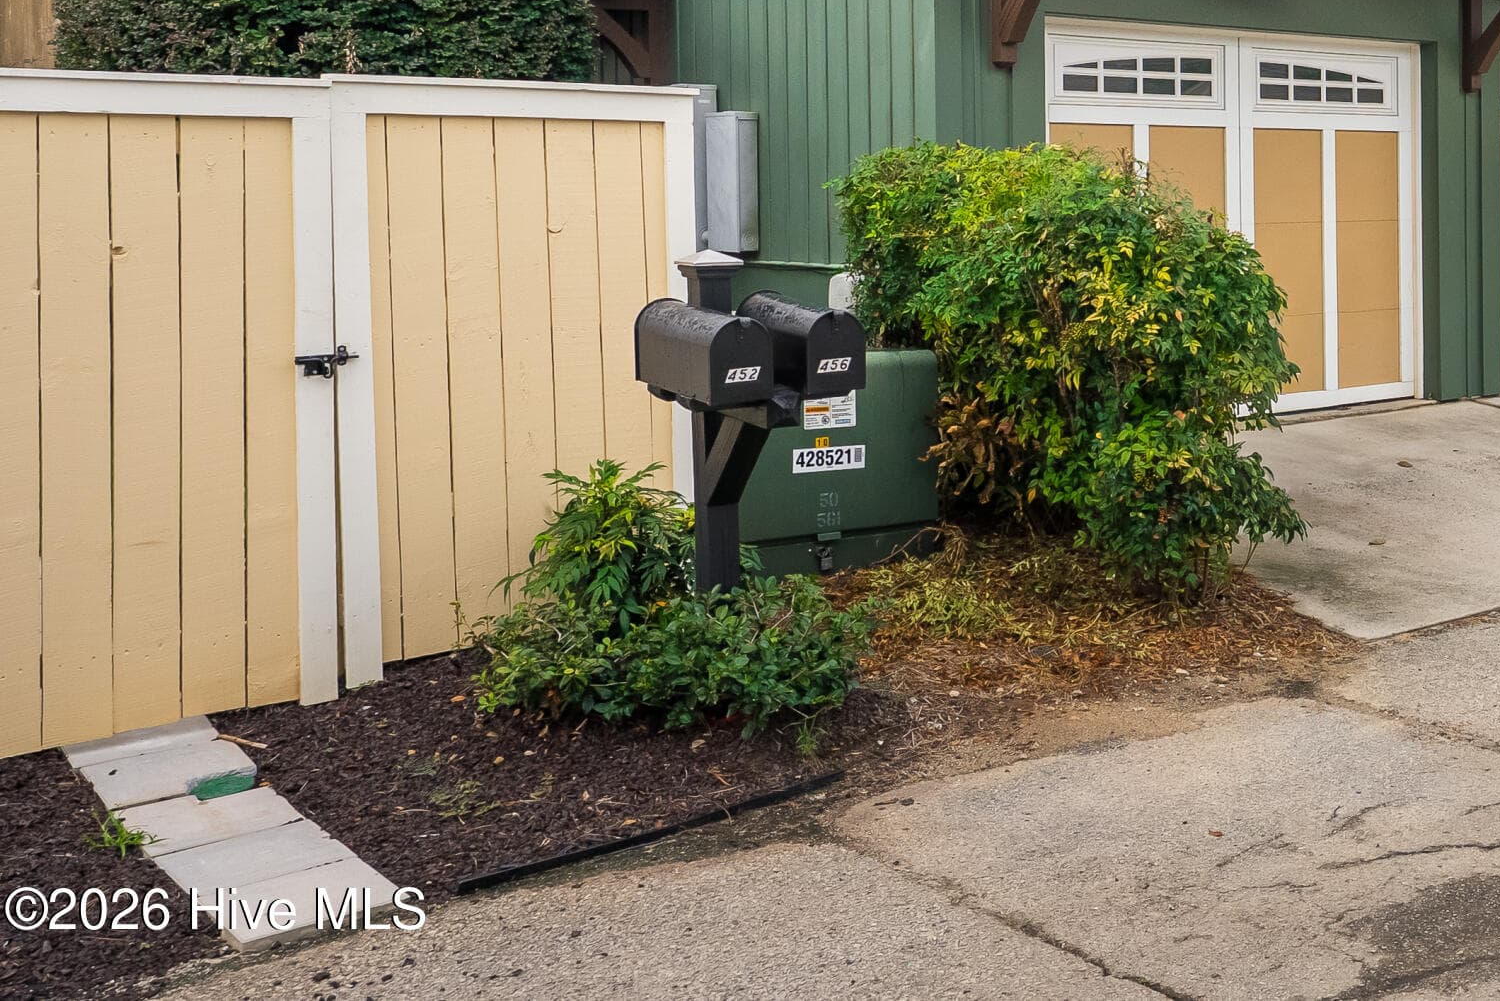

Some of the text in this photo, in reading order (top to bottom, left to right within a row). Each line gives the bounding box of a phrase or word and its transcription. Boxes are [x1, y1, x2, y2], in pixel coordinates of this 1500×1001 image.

[820, 359, 849, 371] 456
[727, 368, 758, 382] 452
[795, 448, 851, 468] 428521
